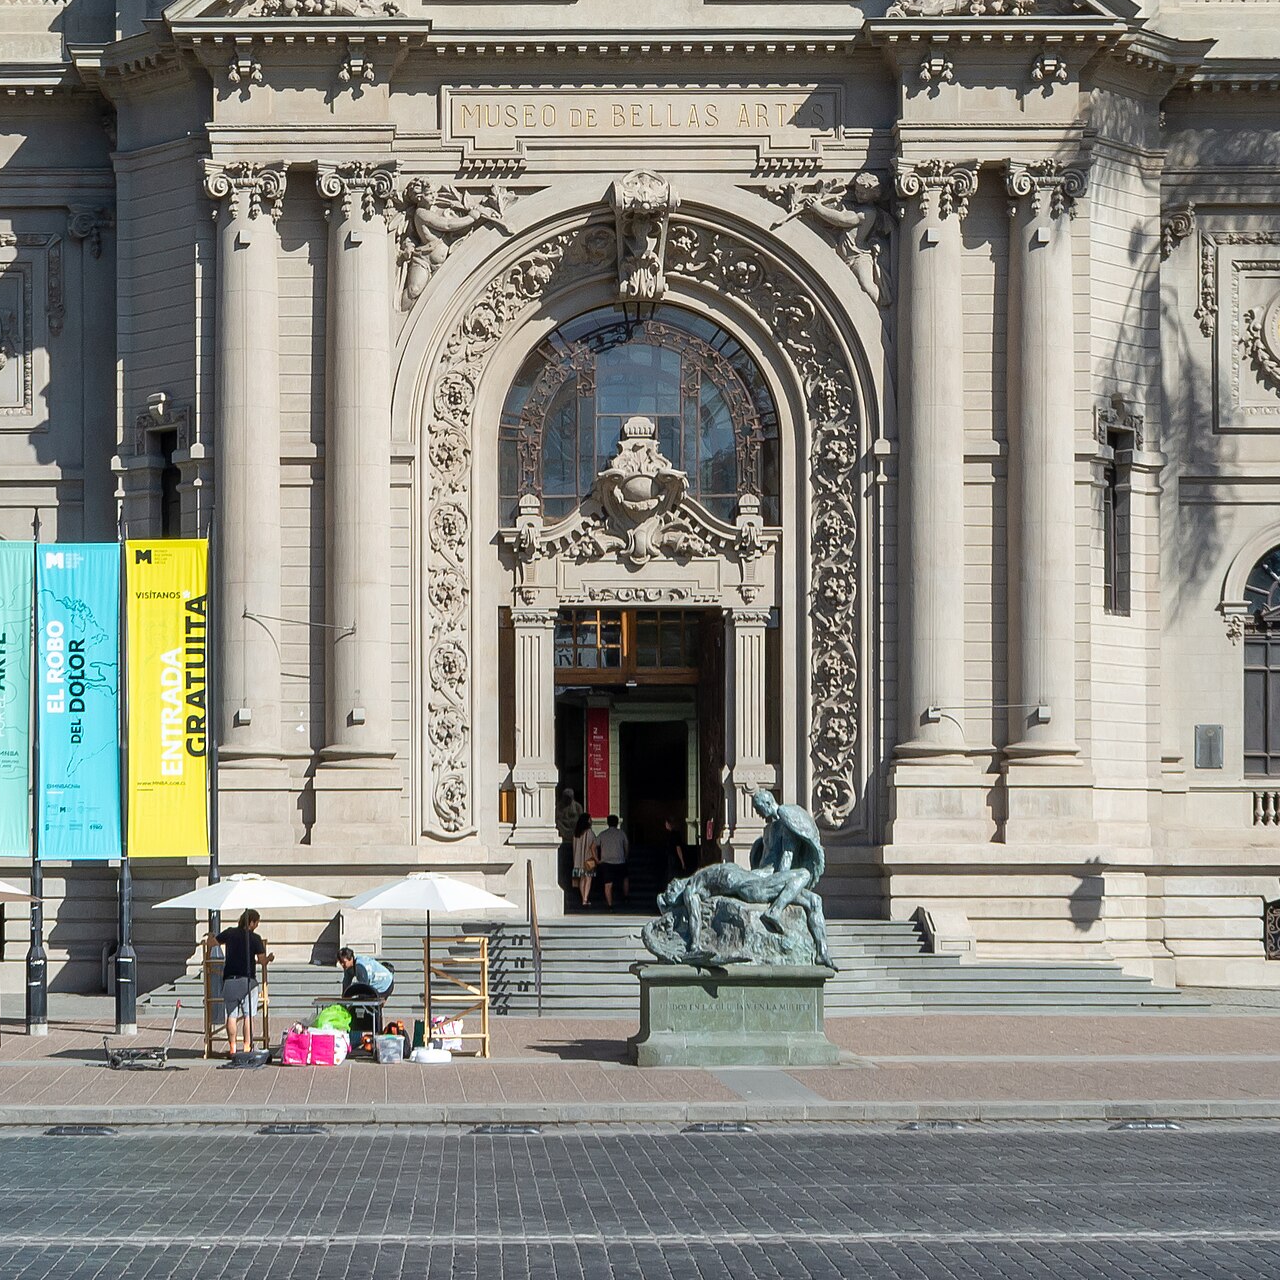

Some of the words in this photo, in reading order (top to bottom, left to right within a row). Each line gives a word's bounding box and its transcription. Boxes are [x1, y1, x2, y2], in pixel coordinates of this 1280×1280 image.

[460, 103, 557, 129] MUSEO
[569, 108, 598, 128] DE
[611, 103, 720, 129] BELLAS
[737, 103, 826, 128] ARTES
[135, 590, 181, 600] VISÍTANOS
[46, 620, 65, 684] ROBO
[68, 638, 86, 713] DOLOR
[184, 593, 208, 758] GRATUITA
[46, 688, 65, 714] EL
[160, 647, 183, 777] ENTRADA
[70, 718, 82, 744] DEL
